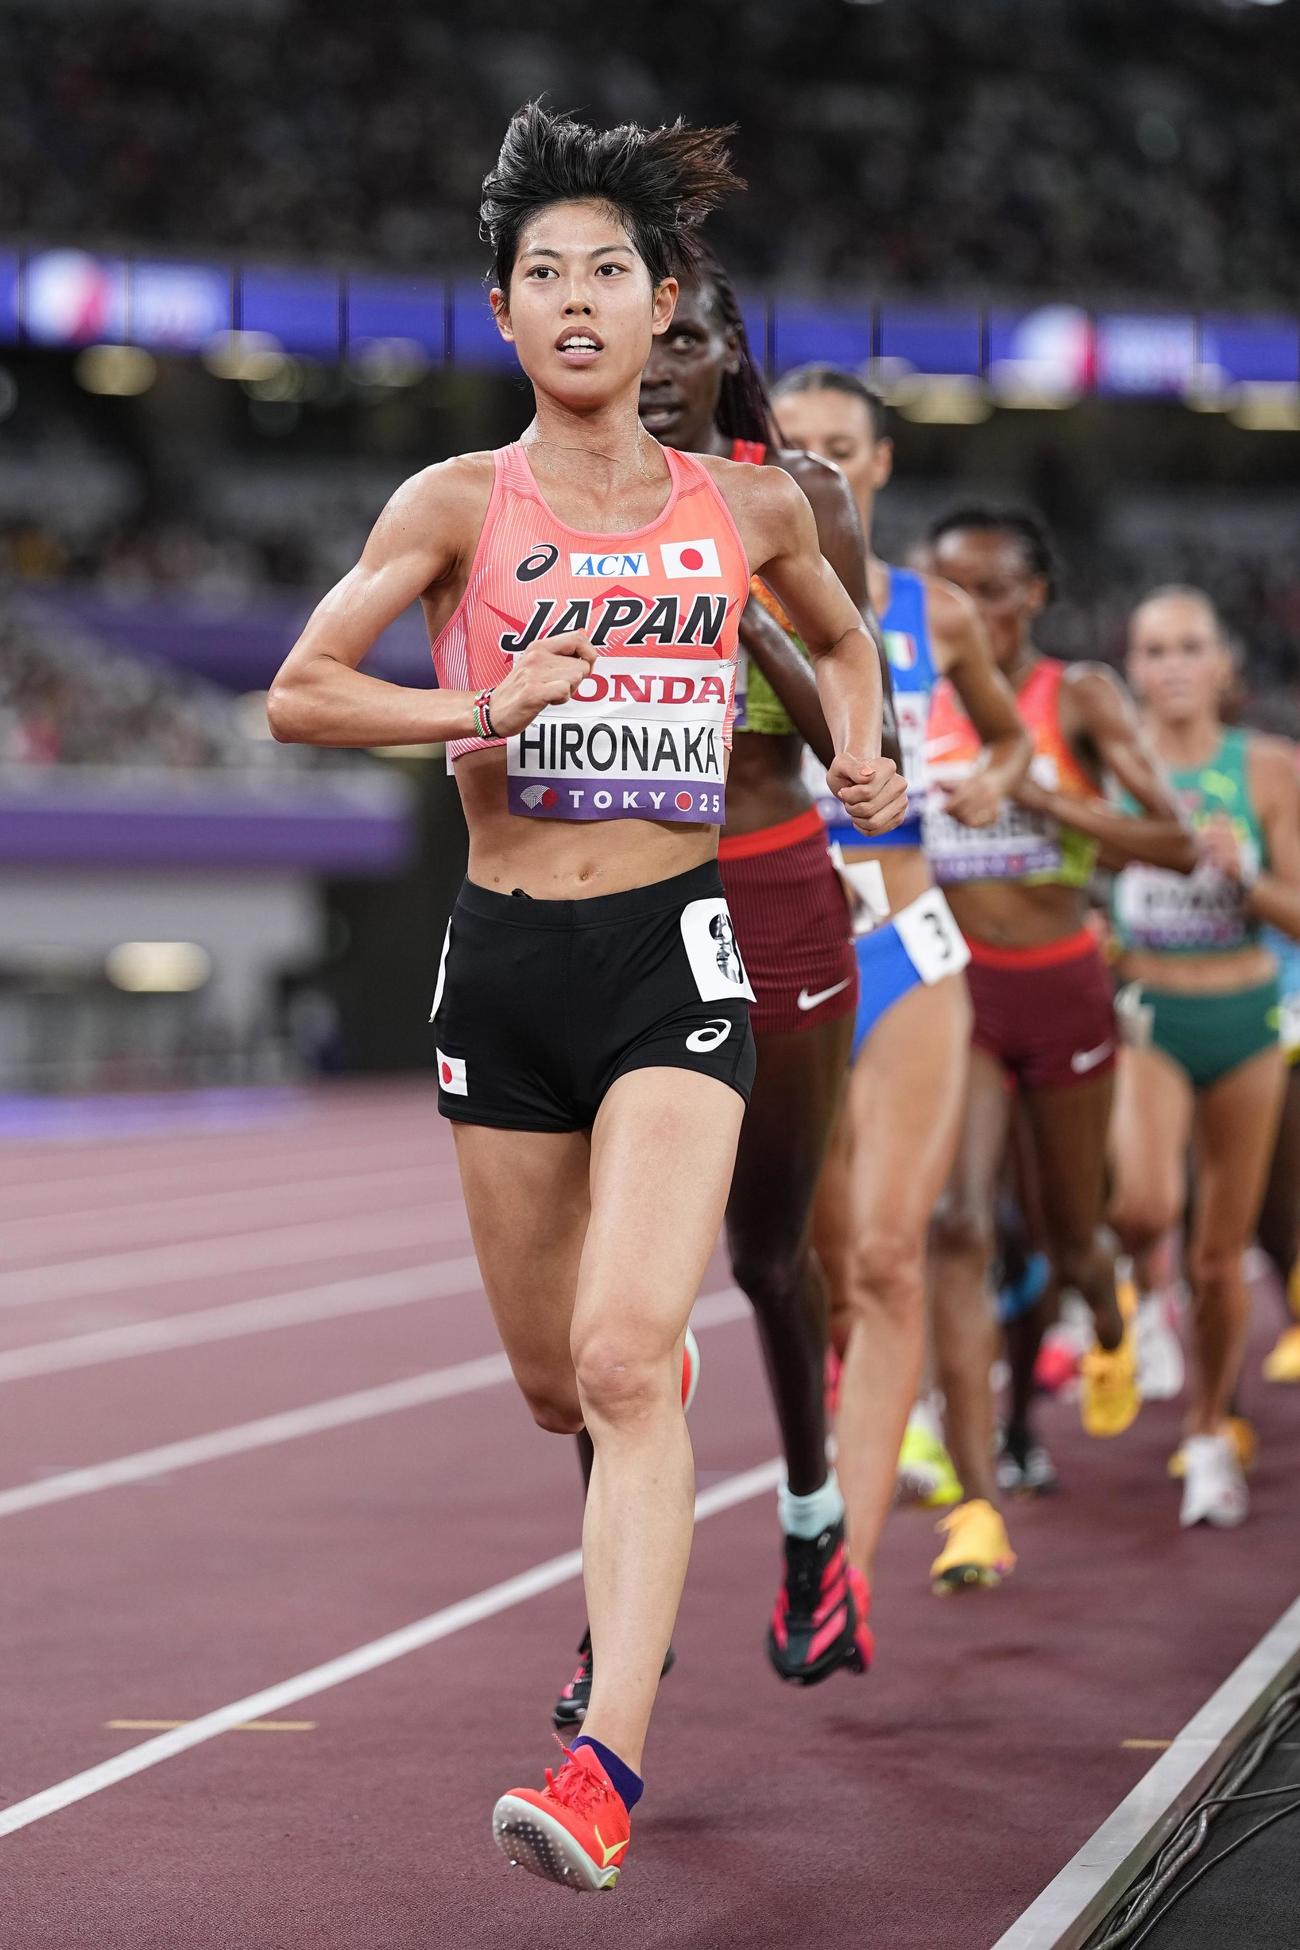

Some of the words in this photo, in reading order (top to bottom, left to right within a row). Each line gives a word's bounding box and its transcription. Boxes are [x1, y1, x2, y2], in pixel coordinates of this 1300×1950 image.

[575, 554, 643, 577] ACN
[500, 595, 728, 652] JAPAN
[570, 673, 726, 705] ONDA
[519, 722, 720, 776] HIRONAKA
[698, 793, 721, 813] 25
